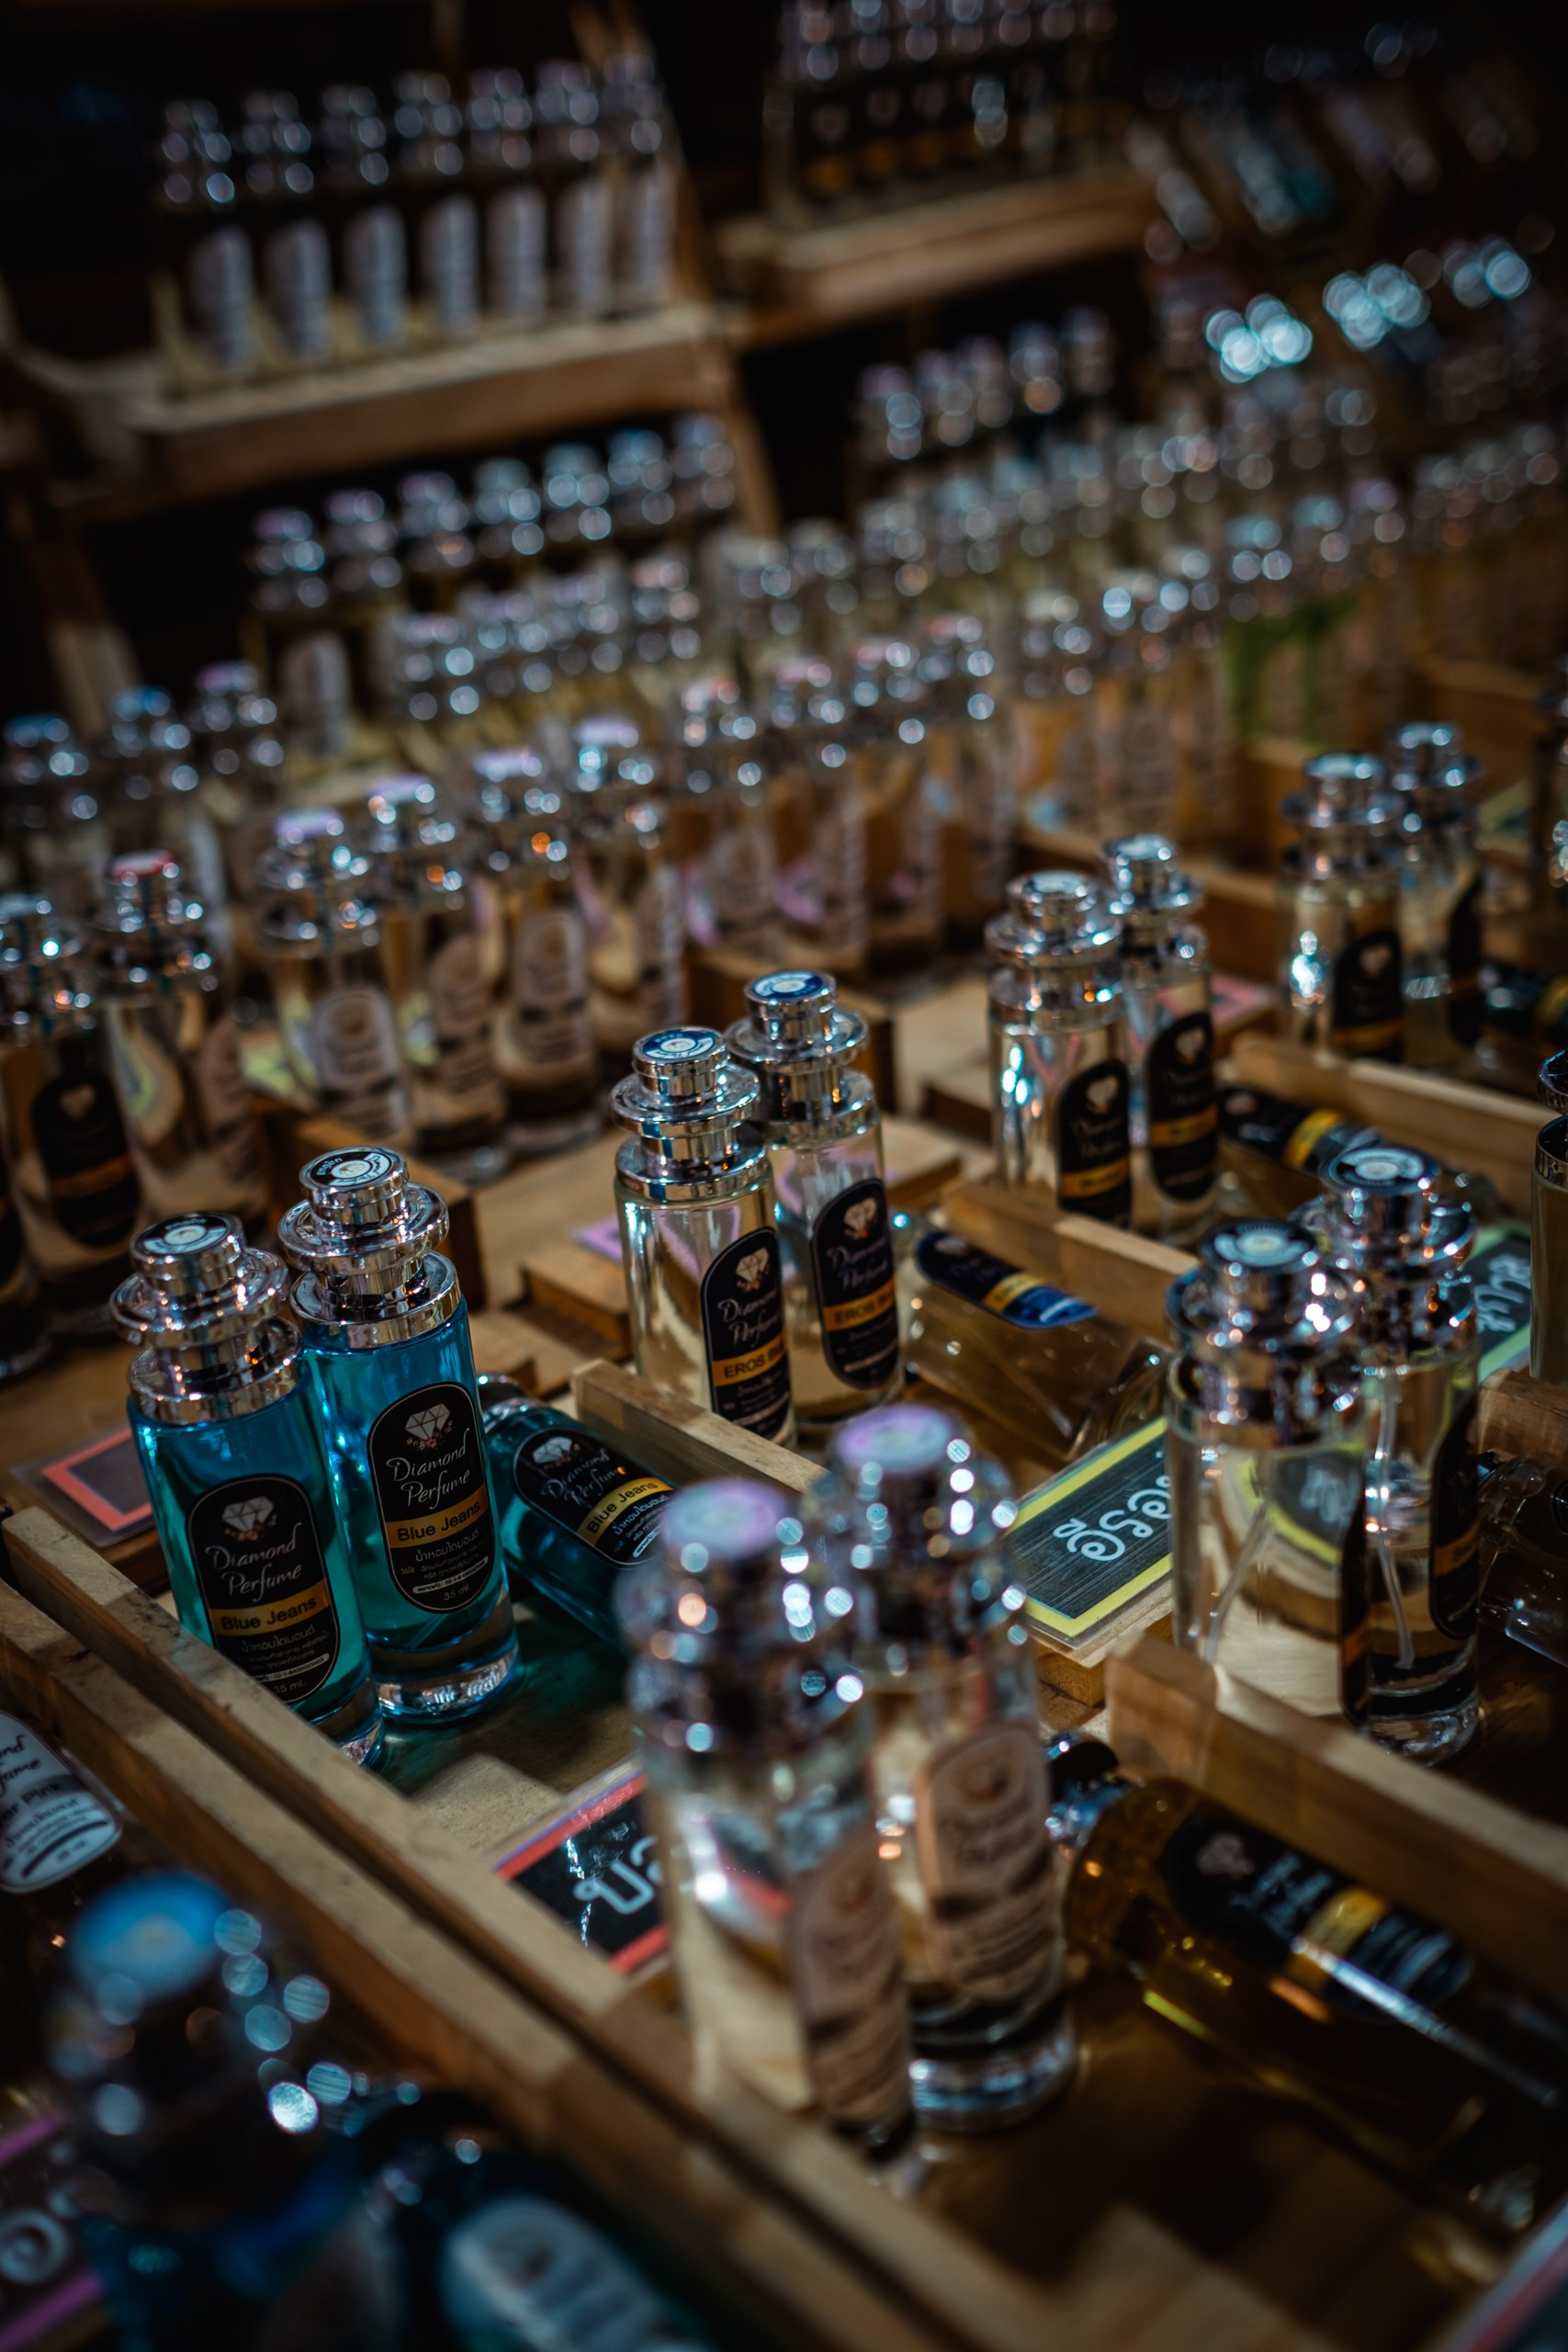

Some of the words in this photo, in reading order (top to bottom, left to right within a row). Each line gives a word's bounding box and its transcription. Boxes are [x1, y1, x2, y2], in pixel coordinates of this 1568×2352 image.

[724, 1353, 766, 1379] EROS
[386, 1427, 470, 1482] Diamond
[400, 1469, 470, 1510] Perfume
[587, 1503, 617, 1534] Blue
[619, 1480, 659, 1504] Jeans
[397, 1524, 436, 1542] Blue
[441, 1501, 481, 1532] Jeans
[205, 1521, 302, 1570] Diamond
[220, 1563, 302, 1602] Perfume
[443, 1590, 457, 1600] 35
[220, 1615, 261, 1631] Blue
[266, 1598, 317, 1624] Jeans
